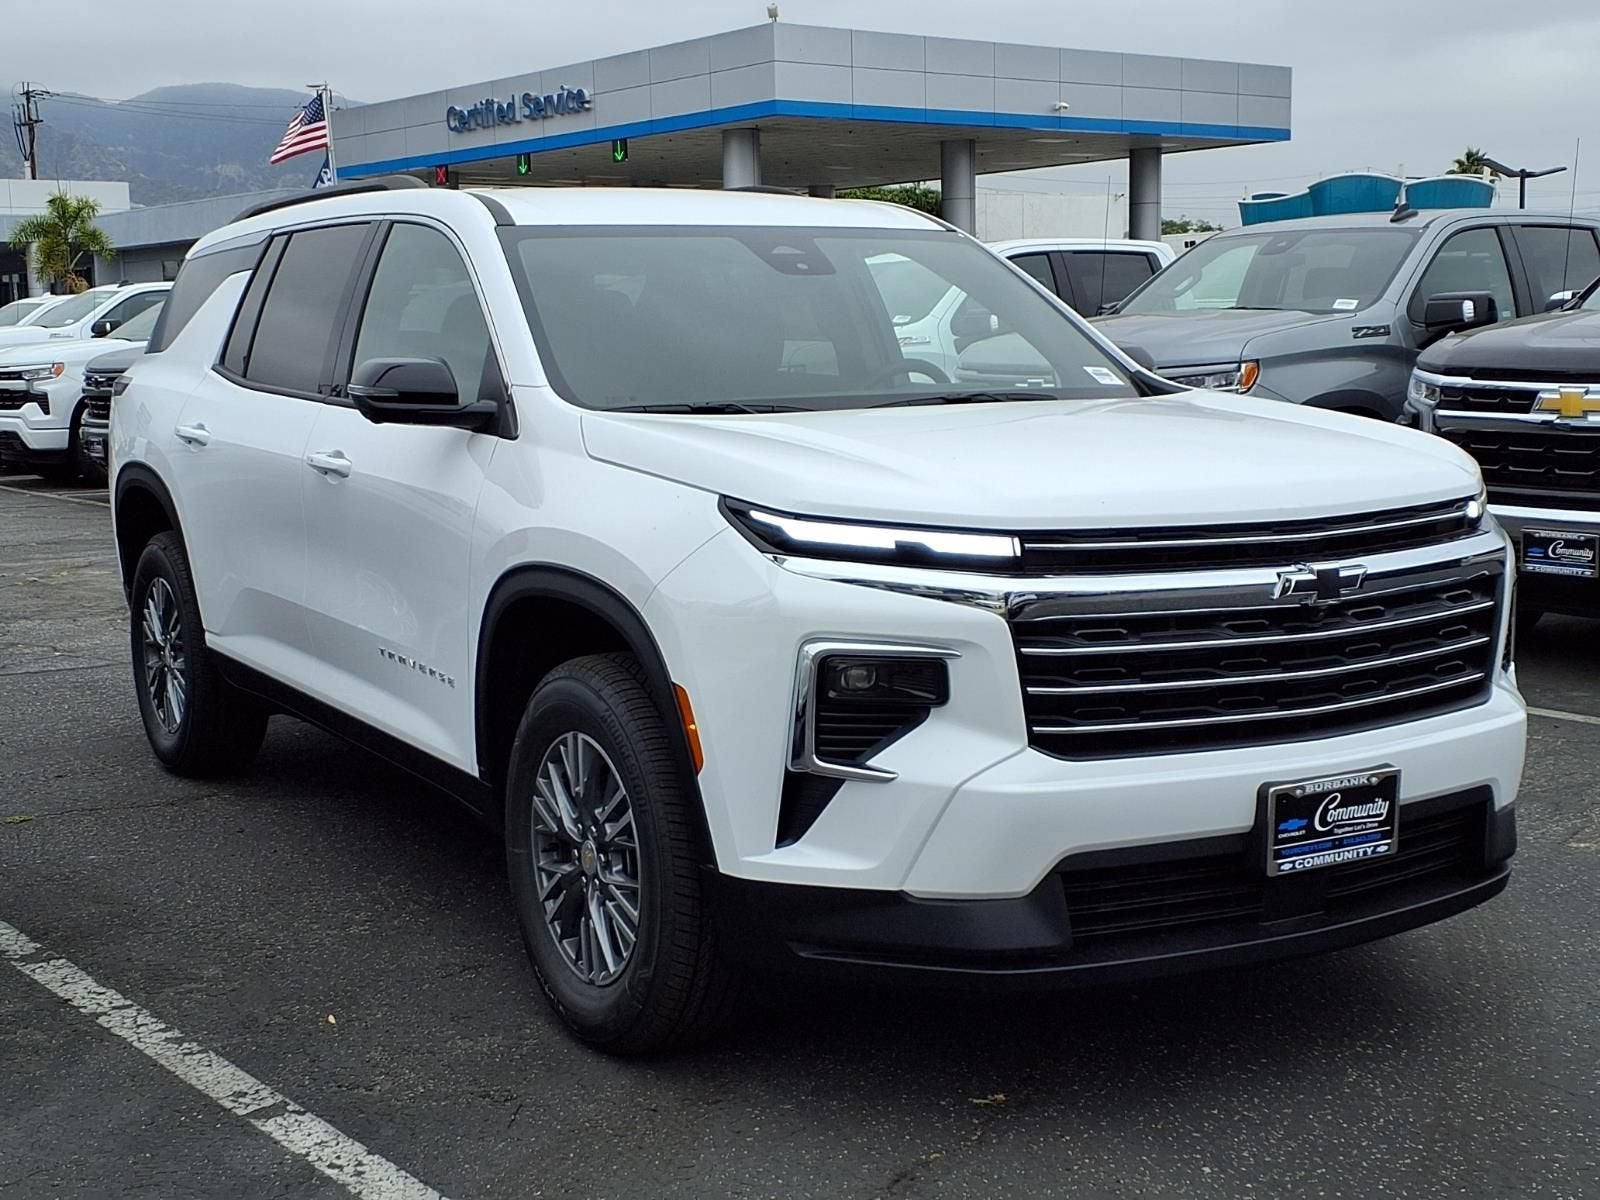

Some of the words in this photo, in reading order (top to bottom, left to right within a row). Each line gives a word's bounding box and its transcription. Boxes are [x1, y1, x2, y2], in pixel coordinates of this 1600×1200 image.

[446, 94, 520, 133] Certified
[521, 85, 592, 120] Service
[1548, 540, 1594, 561] Community
[378, 647, 456, 689] TRAVERSE
[1304, 775, 1369, 794] BURBANK
[1314, 792, 1390, 832] Community
[1294, 846, 1375, 869] COMMUNITY
